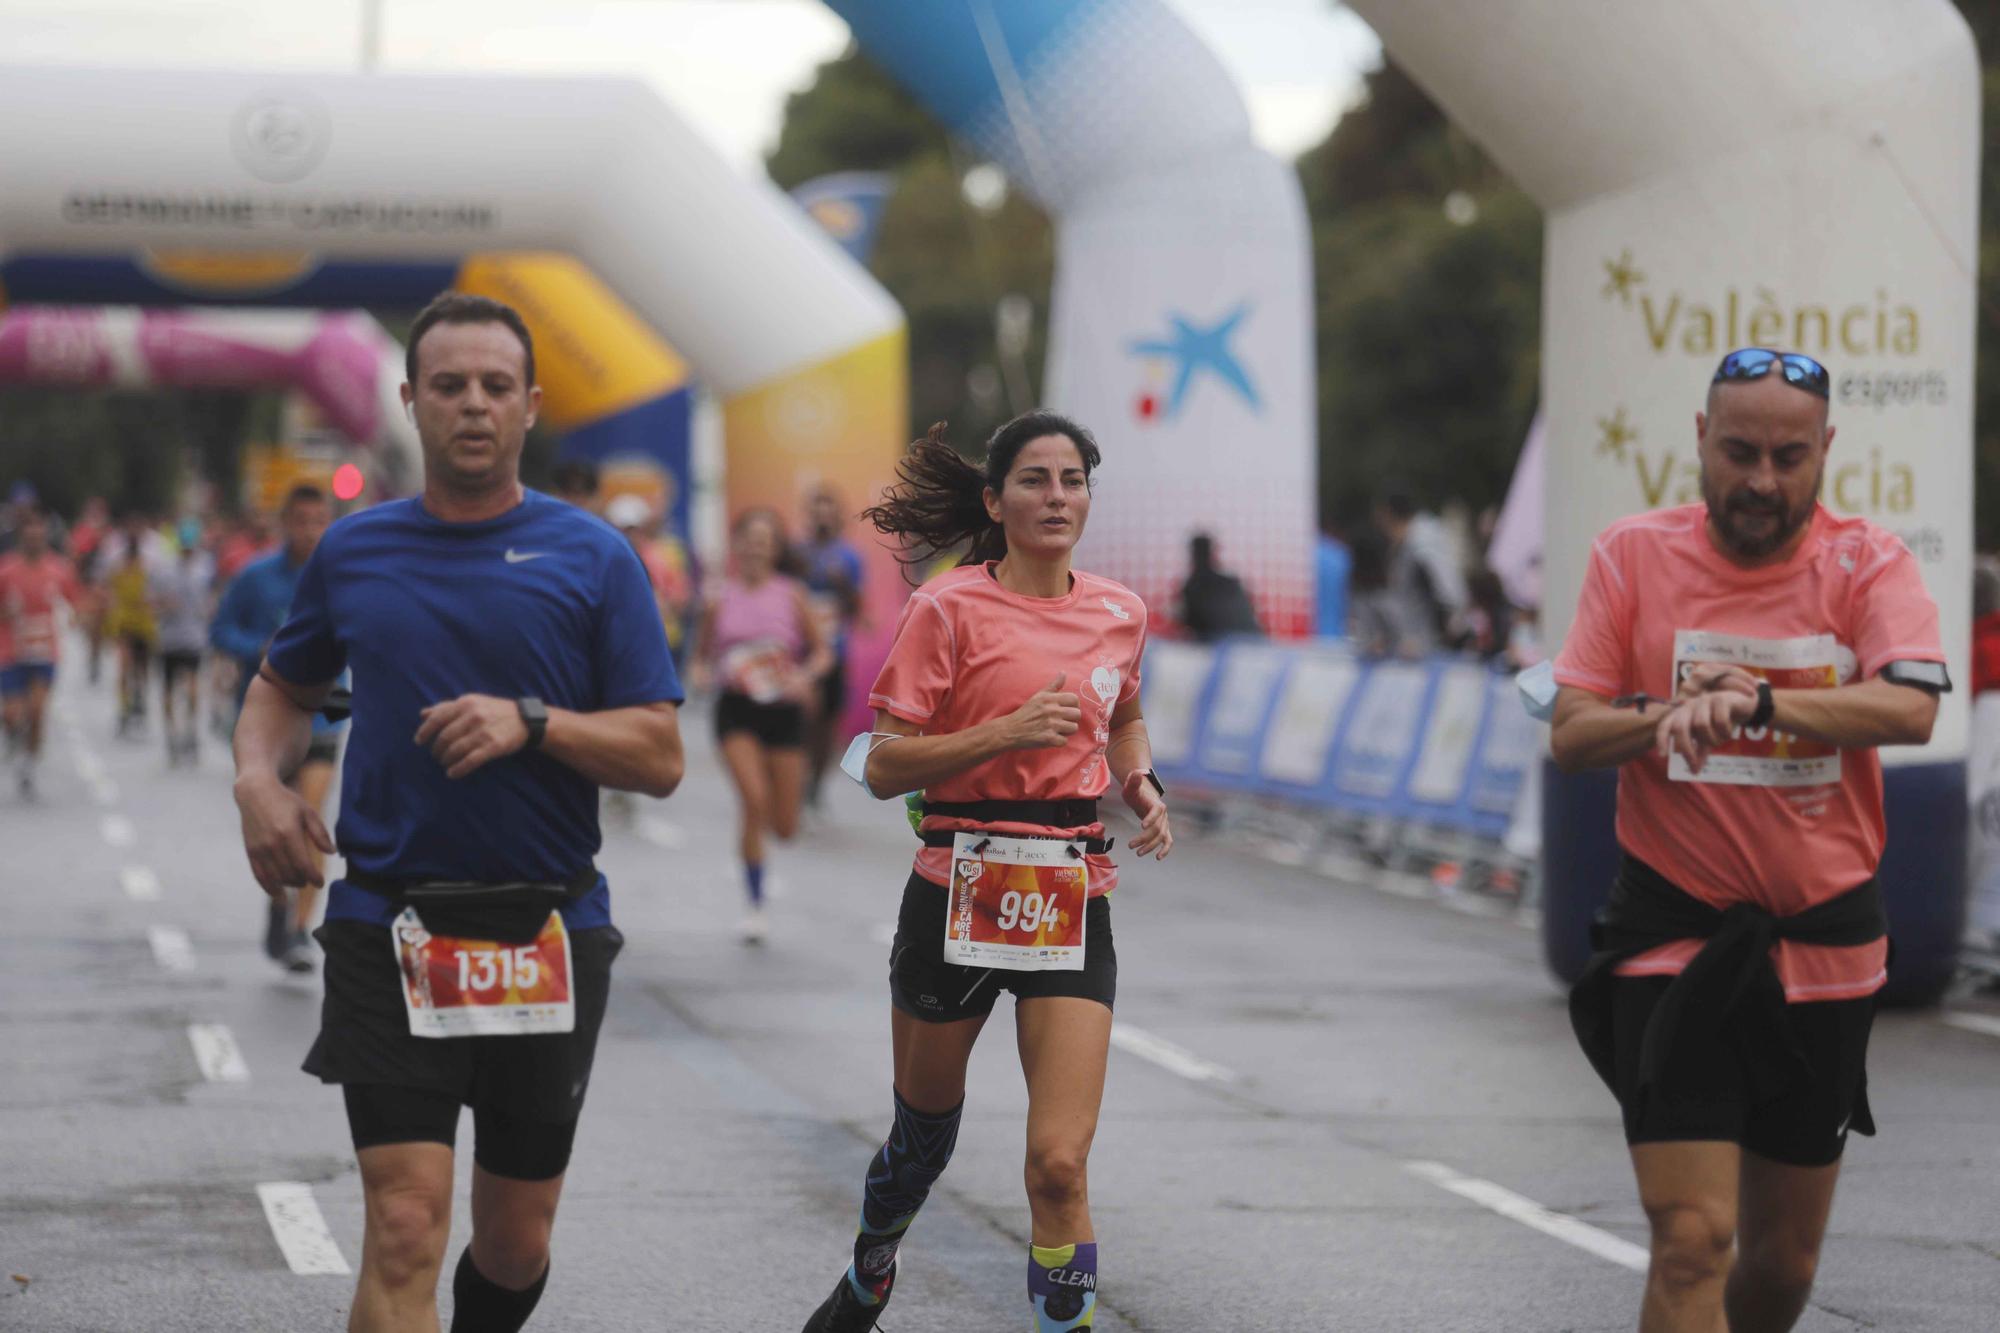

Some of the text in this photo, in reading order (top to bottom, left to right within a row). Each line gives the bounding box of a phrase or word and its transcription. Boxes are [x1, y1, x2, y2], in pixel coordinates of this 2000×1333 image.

[1640, 286, 1921, 355] València
[1838, 368, 1948, 413] esports
[1635, 447, 1914, 514] Vacia
[997, 890, 1059, 933] 994
[453, 944, 538, 992] 1315
[1047, 1268, 1096, 1290] CLEAN
